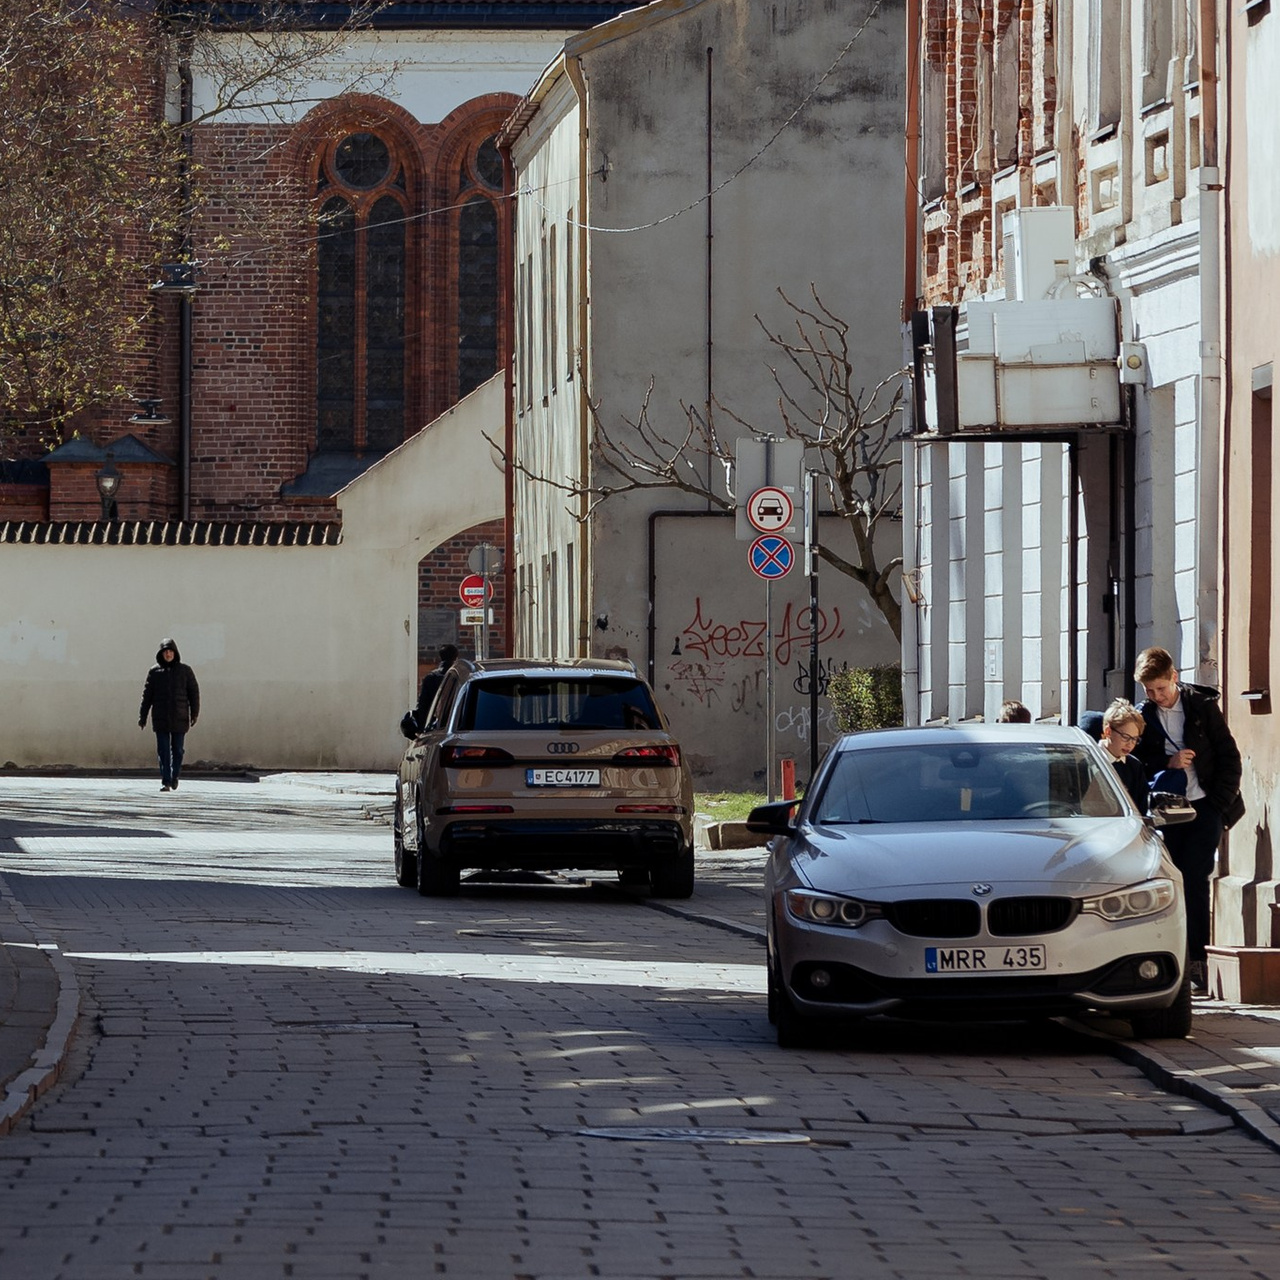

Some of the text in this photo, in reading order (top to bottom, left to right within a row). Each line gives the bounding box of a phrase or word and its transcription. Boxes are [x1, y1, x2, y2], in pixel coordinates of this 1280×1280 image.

[545, 771, 594, 783] EC4177
[940, 948, 1041, 969] MRR 435
